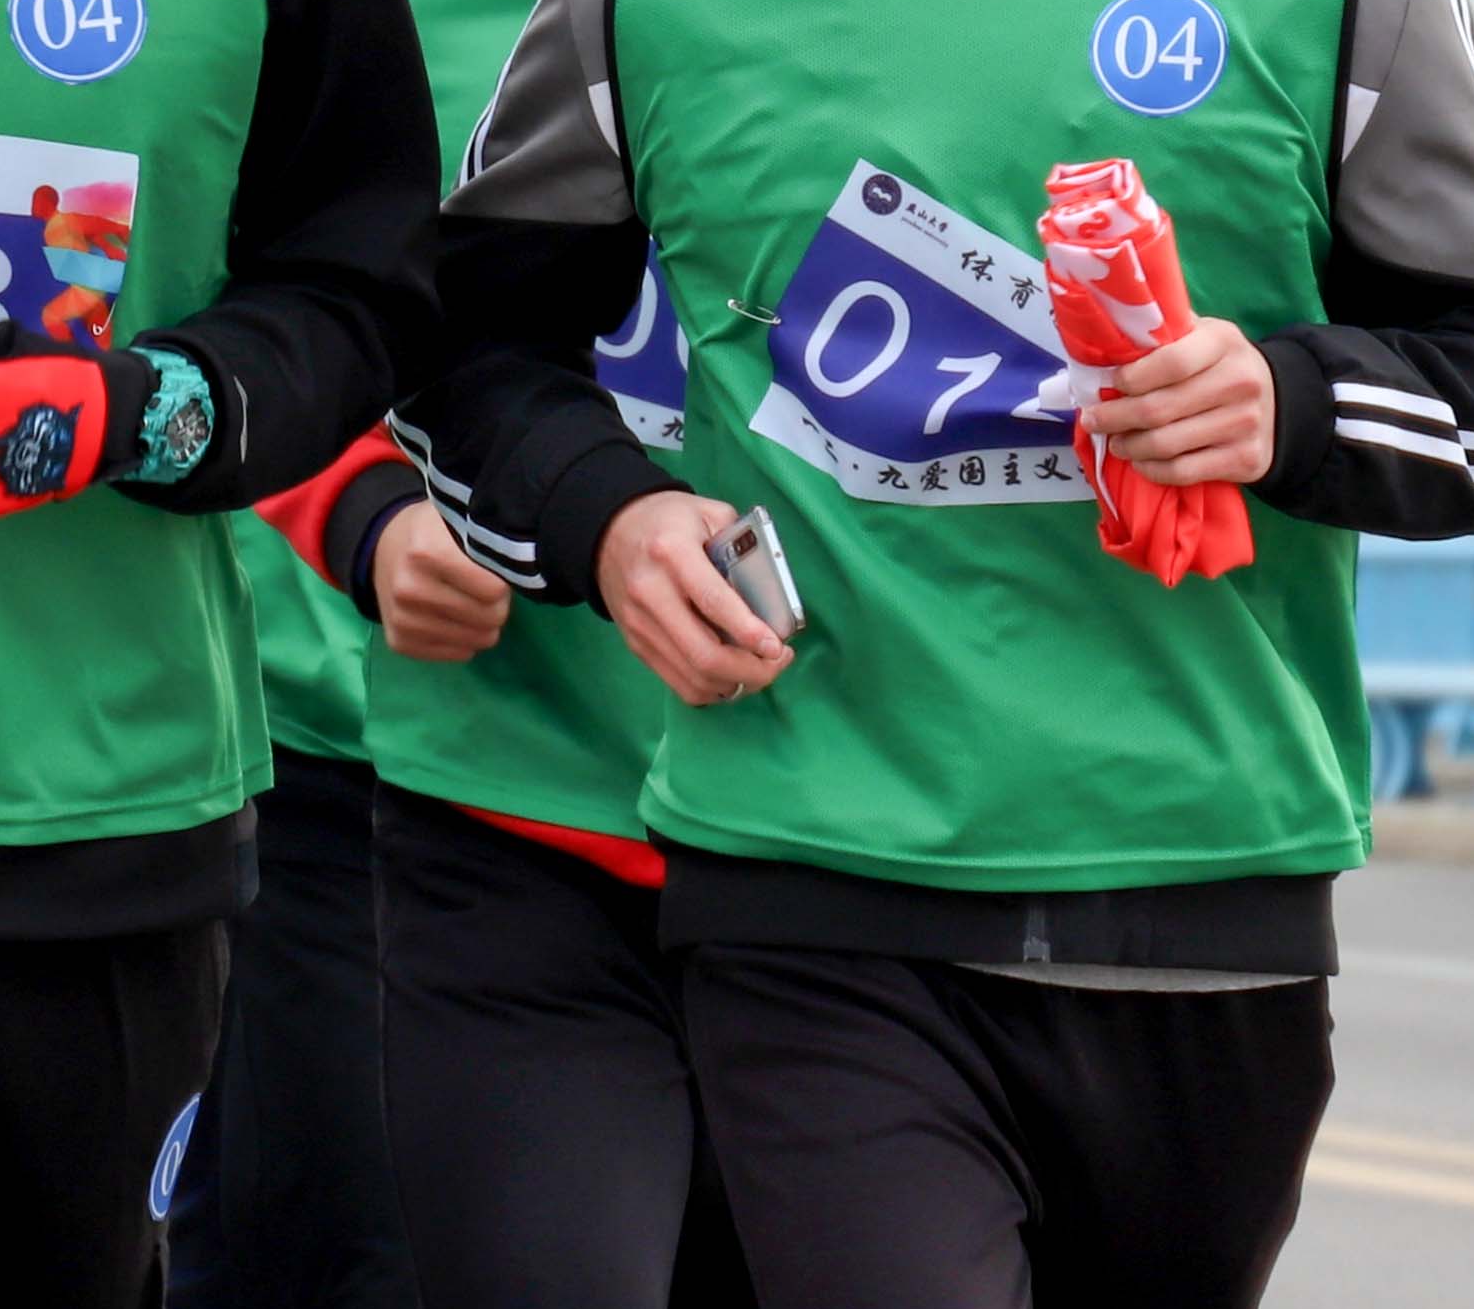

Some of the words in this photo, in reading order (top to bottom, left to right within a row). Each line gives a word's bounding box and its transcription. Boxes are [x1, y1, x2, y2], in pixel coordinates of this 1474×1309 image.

[1112, 14, 1203, 82] 04
[801, 416, 1087, 492] 一二·九爱国主义
